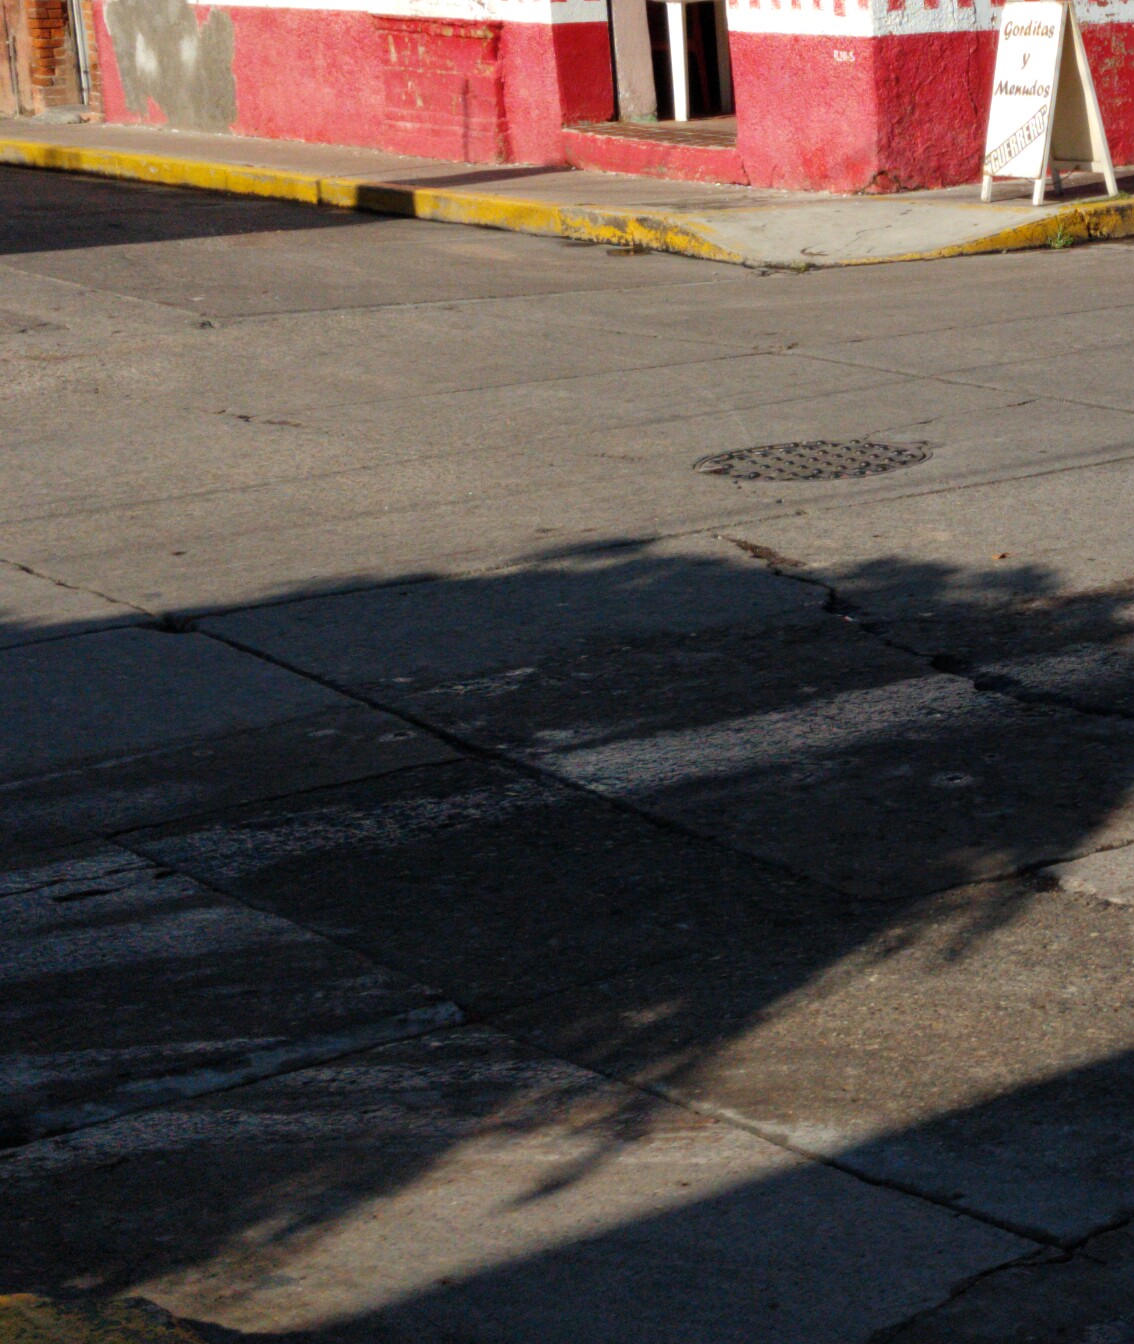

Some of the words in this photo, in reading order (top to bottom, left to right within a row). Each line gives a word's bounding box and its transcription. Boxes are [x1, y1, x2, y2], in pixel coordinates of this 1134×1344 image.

[1004, 20, 1056, 41] Gorditas
[1021, 52, 1031, 70] y
[994, 80, 1051, 99] Menudos
